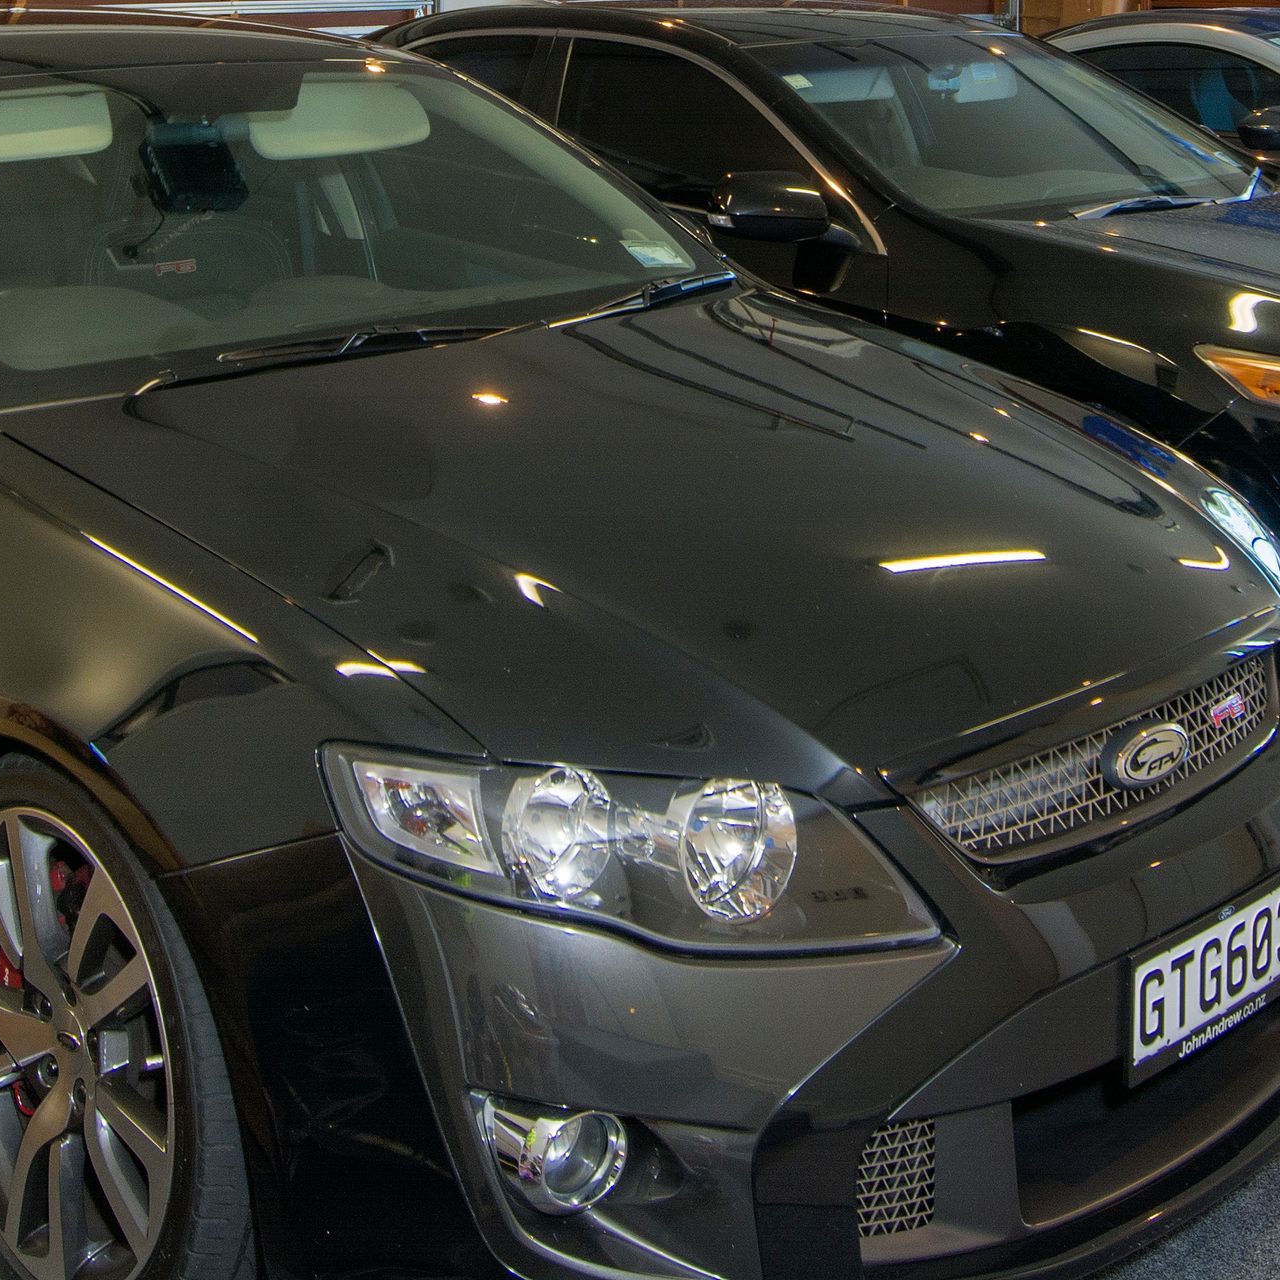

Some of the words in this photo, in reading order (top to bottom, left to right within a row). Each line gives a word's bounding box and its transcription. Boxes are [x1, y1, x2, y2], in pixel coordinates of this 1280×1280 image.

[1211, 693, 1245, 728] F6
[1147, 746, 1183, 776] FPV
[1178, 993, 1267, 1058] JohnAndrew.co.nz
